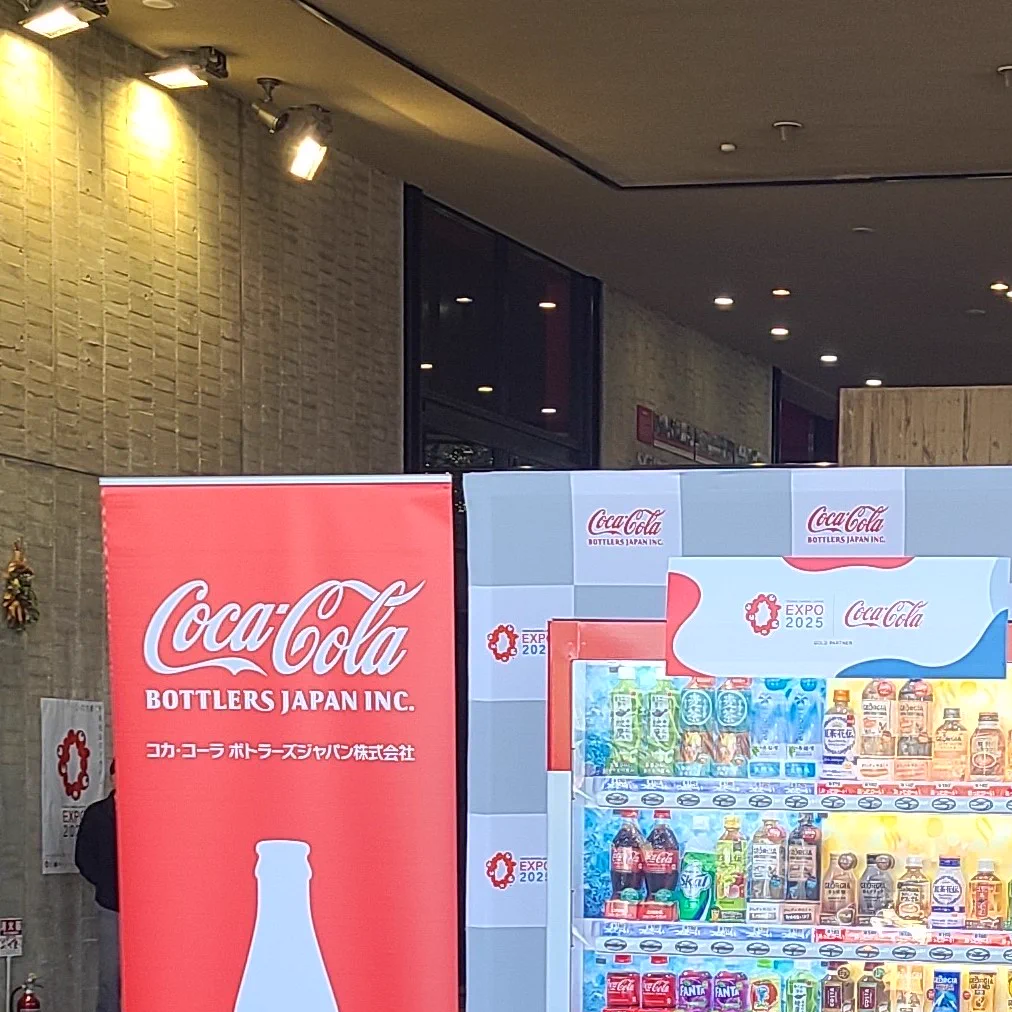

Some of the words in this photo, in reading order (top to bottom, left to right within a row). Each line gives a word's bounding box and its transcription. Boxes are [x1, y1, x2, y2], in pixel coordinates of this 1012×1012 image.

[587, 509, 665, 535] Coca-Cola
[808, 506, 889, 533] Coca-Cola
[785, 604, 824, 616] EXPO
[844, 600, 928, 628] Coca-Cola
[143, 579, 426, 677] Coca-Cola
[785, 617, 824, 629] 2025
[521, 633, 548, 644] EXP
[522, 645, 546, 655] 202
[145, 689, 275, 712] BOTTLERS
[280, 690, 358, 715] JAPAN
[364, 691, 415, 712] INC.
[146, 743, 225, 759] コカ・コーラ
[228, 742, 416, 762] ボトラーズジャパン株式会社
[519, 872, 548, 883] 202
[679, 984, 706, 997] FANTA
[714, 986, 740, 998] FANTA
